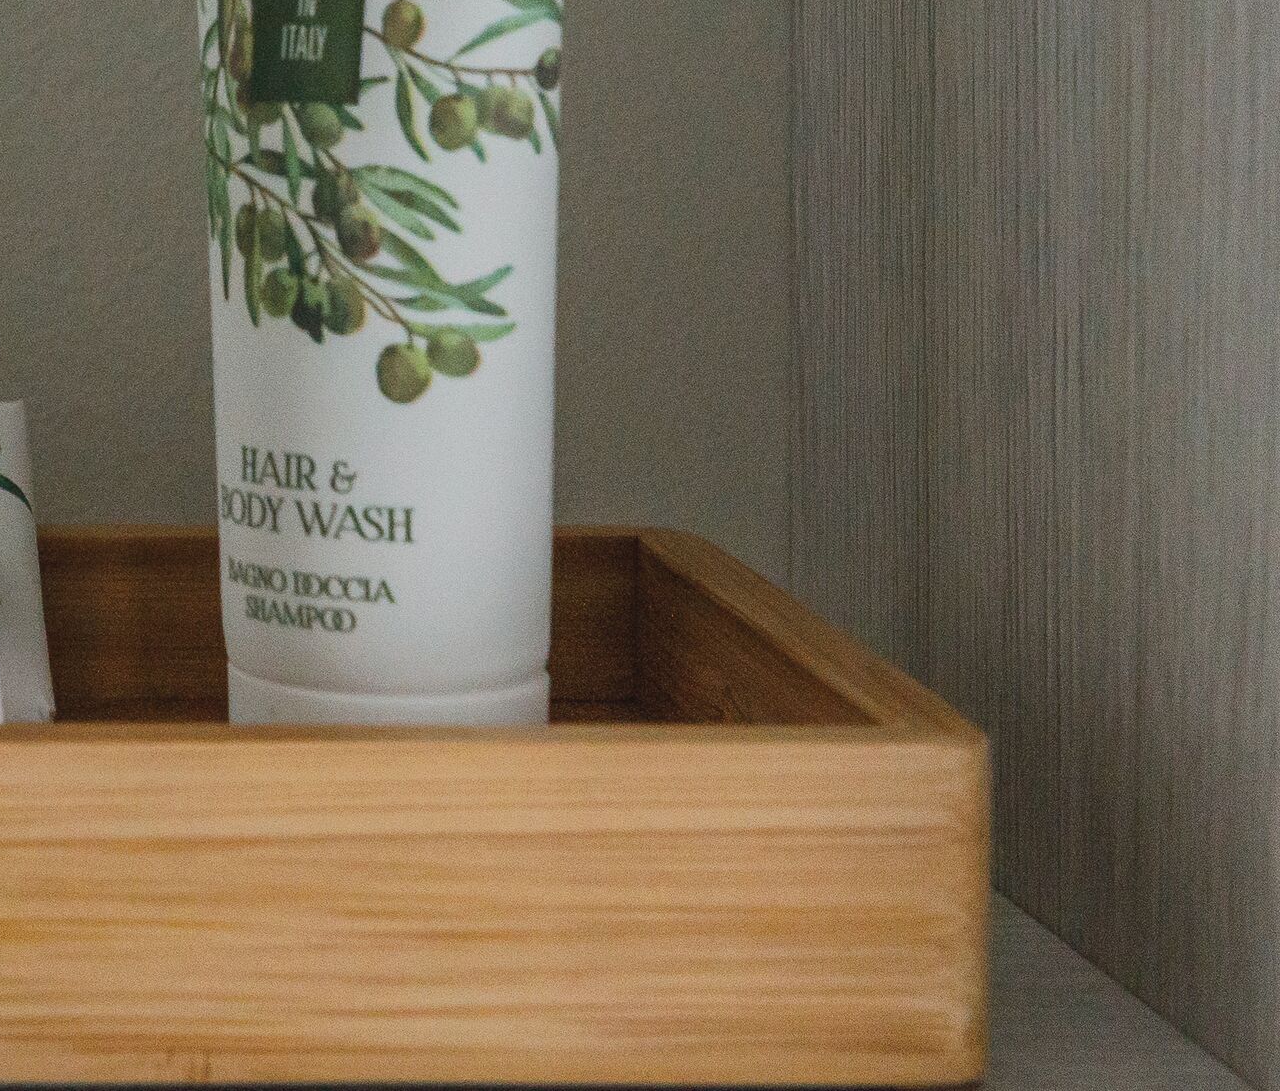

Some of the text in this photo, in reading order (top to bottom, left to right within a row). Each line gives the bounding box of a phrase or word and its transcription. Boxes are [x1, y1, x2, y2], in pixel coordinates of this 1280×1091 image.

[281, 24, 329, 61] ITALY
[241, 445, 357, 495] HAIR &
[294, 499, 415, 543] WASH
[292, 570, 397, 604] DOCCIA
[244, 594, 357, 633] SHAMPOO
